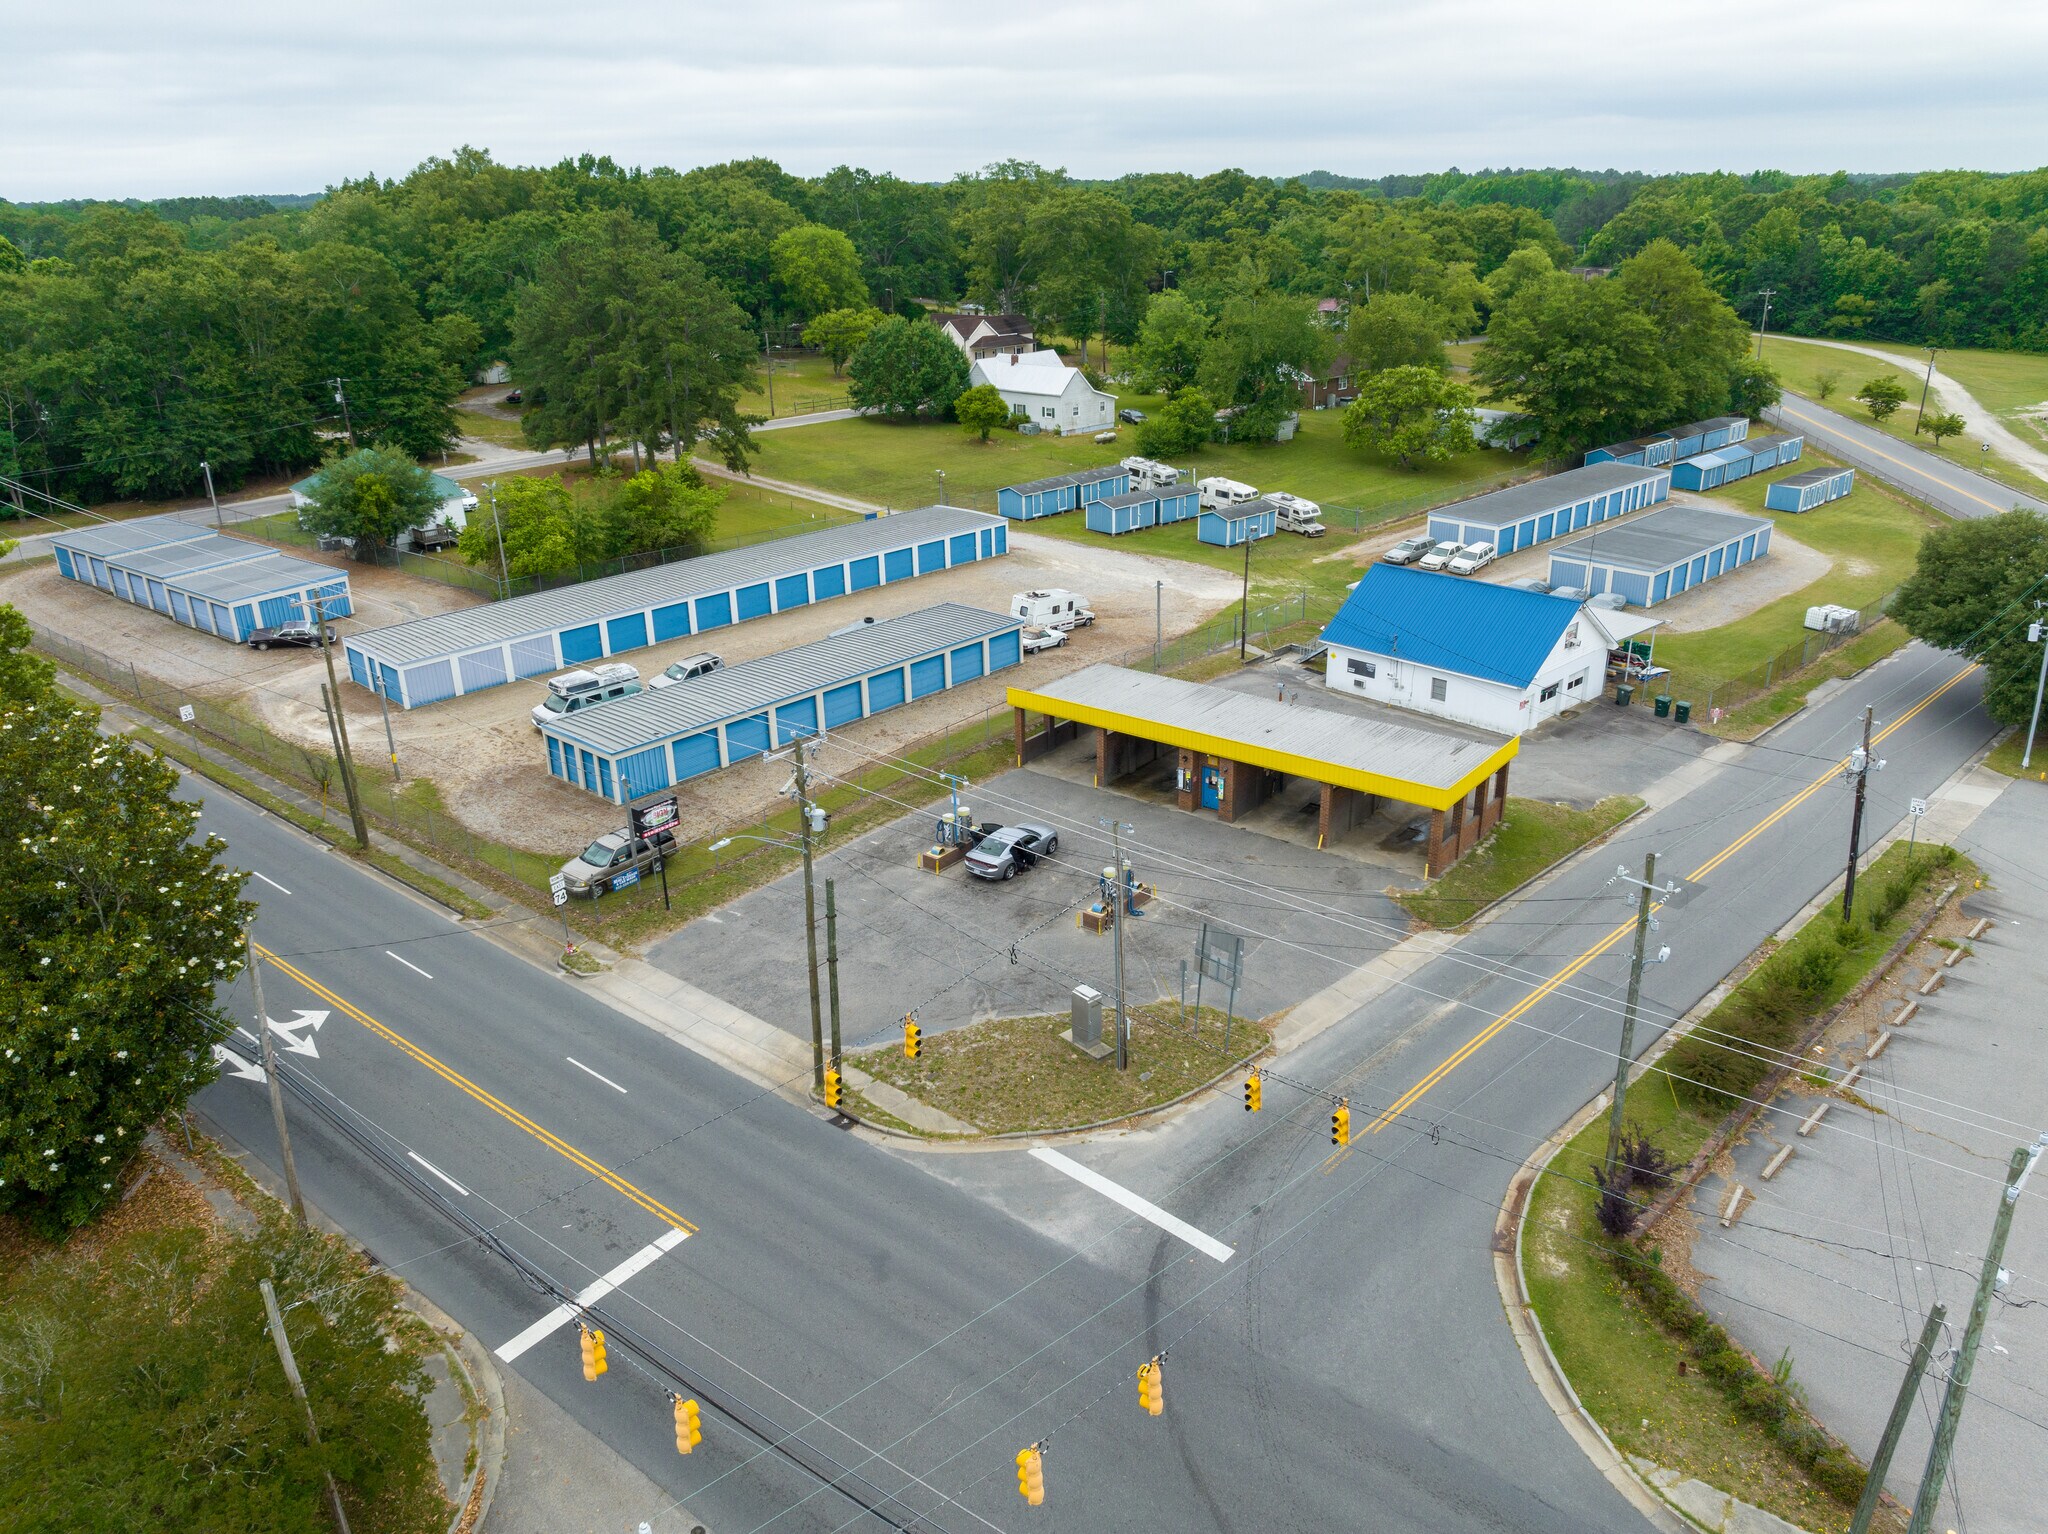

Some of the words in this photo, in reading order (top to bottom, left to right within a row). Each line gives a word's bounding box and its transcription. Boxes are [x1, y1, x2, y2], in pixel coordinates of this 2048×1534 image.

[182, 712, 193, 720] 35
[1911, 806, 1924, 814] 35
[555, 891, 566, 904] 74
